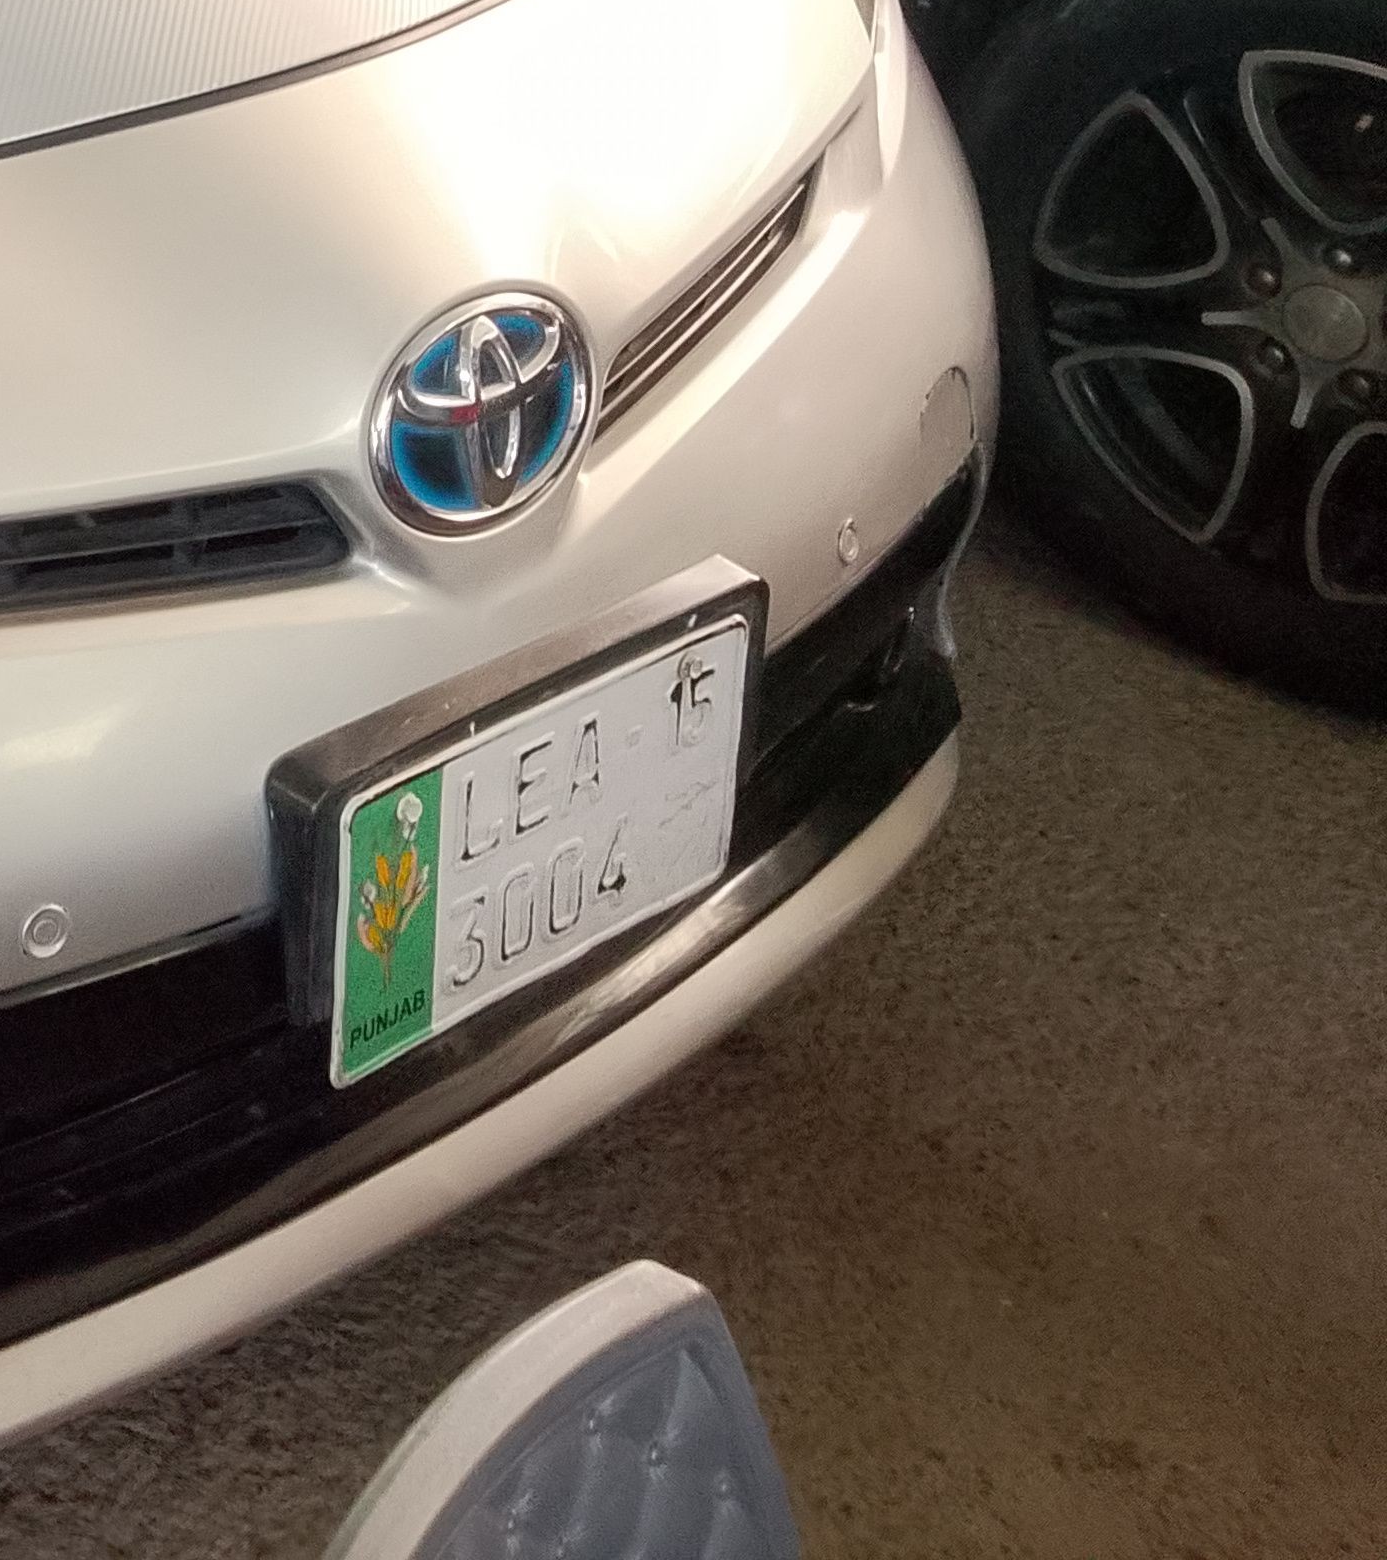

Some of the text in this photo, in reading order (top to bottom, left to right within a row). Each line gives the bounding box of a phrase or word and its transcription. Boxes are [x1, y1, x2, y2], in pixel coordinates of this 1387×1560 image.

[455, 711, 603, 868] LEA
[447, 816, 629, 992] 3004
[349, 987, 426, 1050] PUNJAB
